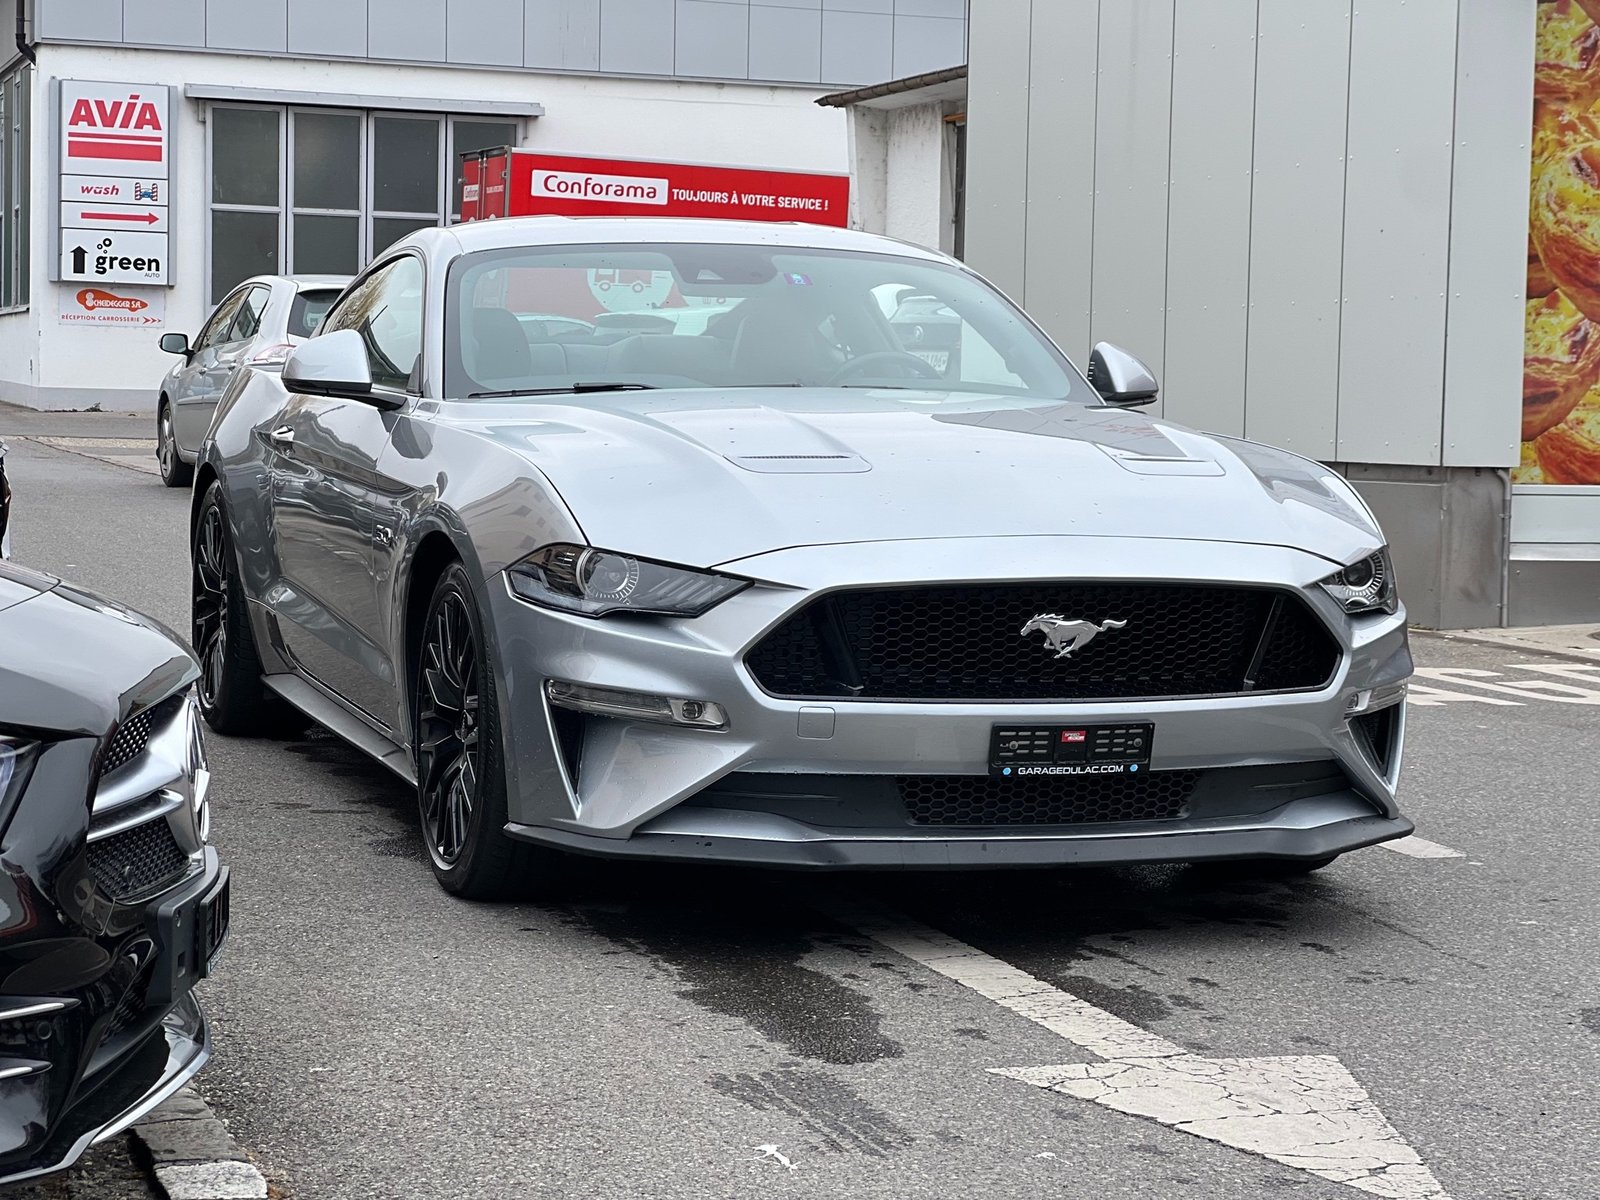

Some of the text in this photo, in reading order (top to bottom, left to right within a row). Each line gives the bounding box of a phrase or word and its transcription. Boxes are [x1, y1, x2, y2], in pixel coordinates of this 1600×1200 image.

[68, 94, 162, 131] AVIA
[80, 184, 120, 196] wash
[543, 174, 657, 199] Conforama
[672, 188, 829, 211] TOUJOURS À VOTRE SERVICE !
[95, 255, 160, 275] green
[61, 313, 96, 321] RÉCEPTION
[1017, 764, 1124, 775] GARAGEDULAC.COM
